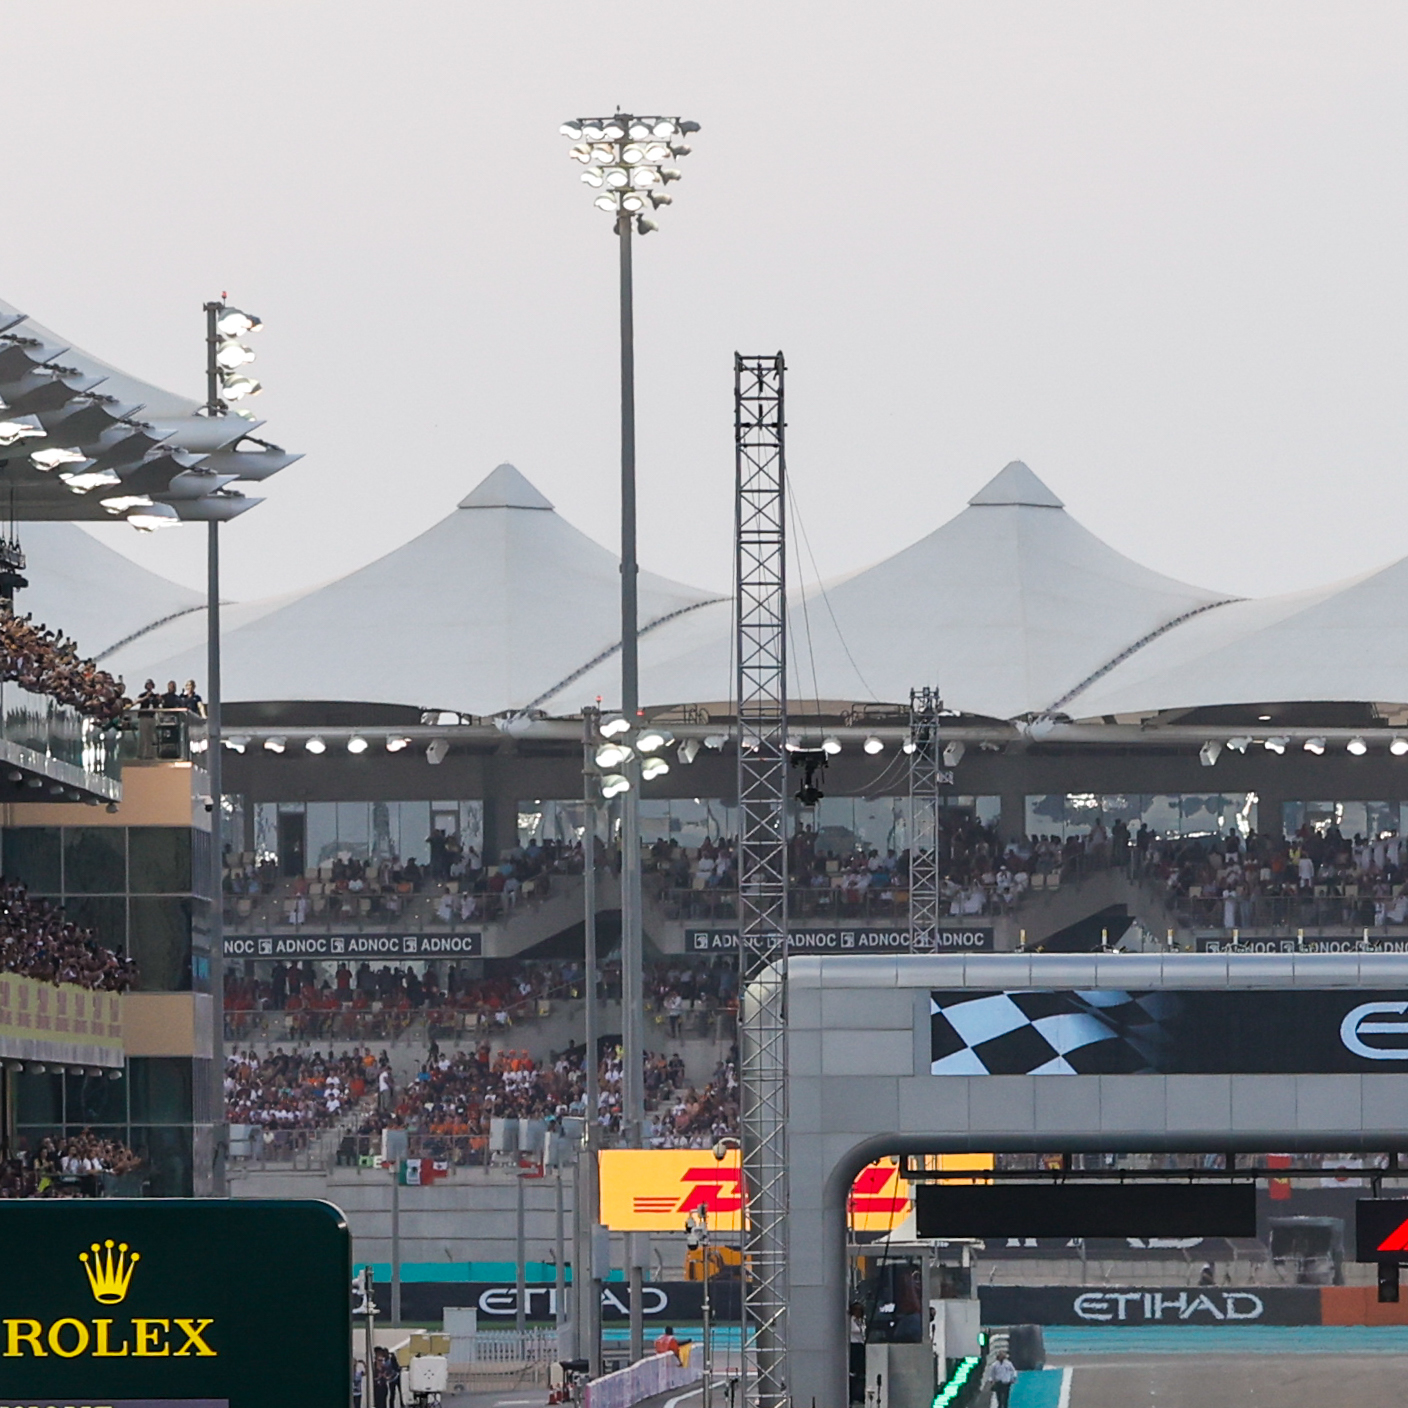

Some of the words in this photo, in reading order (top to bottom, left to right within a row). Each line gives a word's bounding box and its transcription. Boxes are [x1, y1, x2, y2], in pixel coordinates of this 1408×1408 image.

[224, 939, 254, 954] NOC
[276, 938, 327, 953] ADNOC
[348, 937, 399, 953] ADNOC
[420, 936, 472, 952] ADNOC
[858, 932, 911, 947] ADNOC
[478, 1287, 669, 1315] ETIAD
[1073, 1292, 1264, 1321] ETIHAD
[2, 1316, 218, 1359] ROLEX
